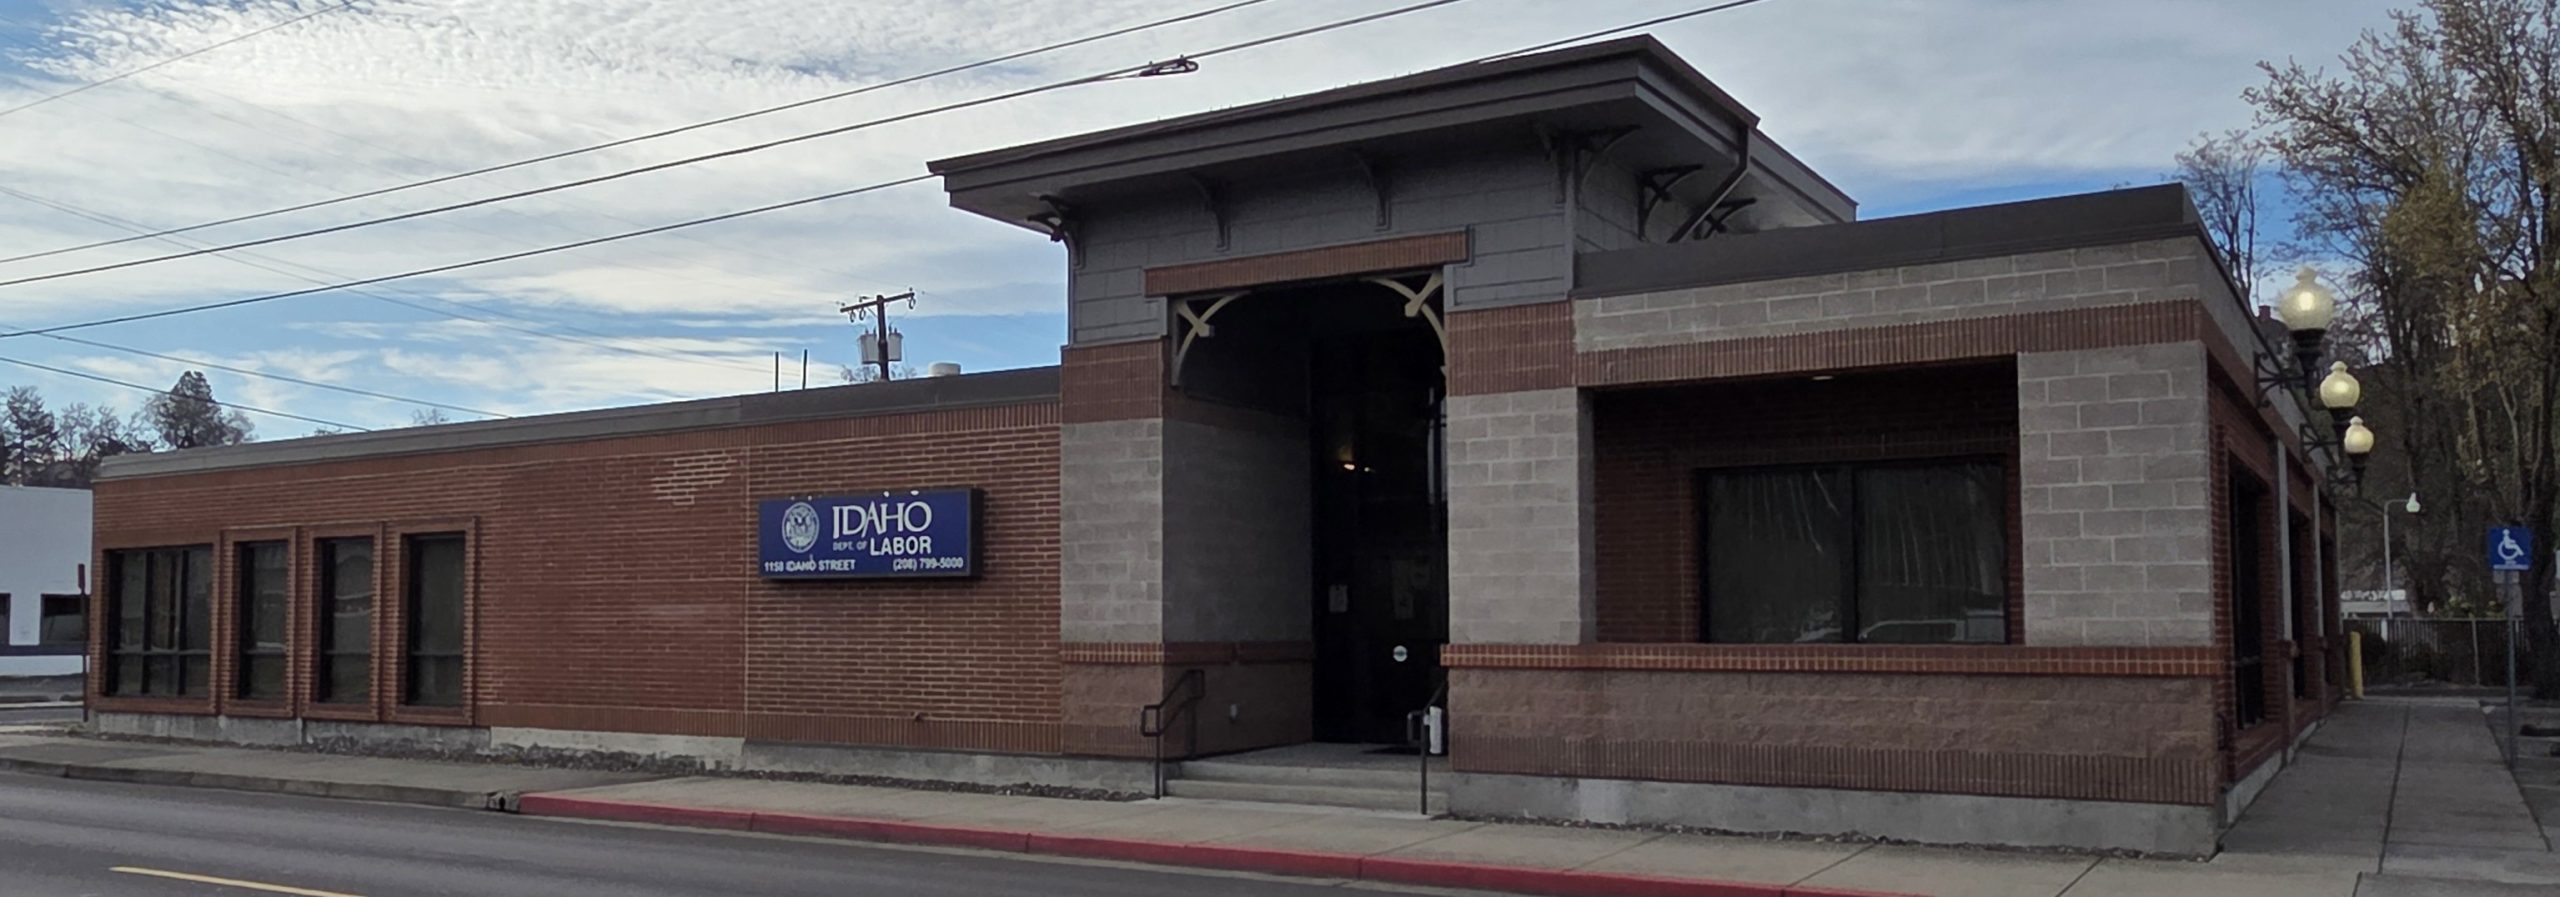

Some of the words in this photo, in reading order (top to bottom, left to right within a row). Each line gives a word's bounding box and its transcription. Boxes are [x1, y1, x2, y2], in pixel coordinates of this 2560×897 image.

[832, 500, 932, 539] IDAHO
[857, 540, 868, 550] OF
[870, 536, 932, 556] LABOR
[786, 560, 815, 572] IDAHO
[818, 559, 856, 571] STREET
[893, 558, 917, 572] (208)
